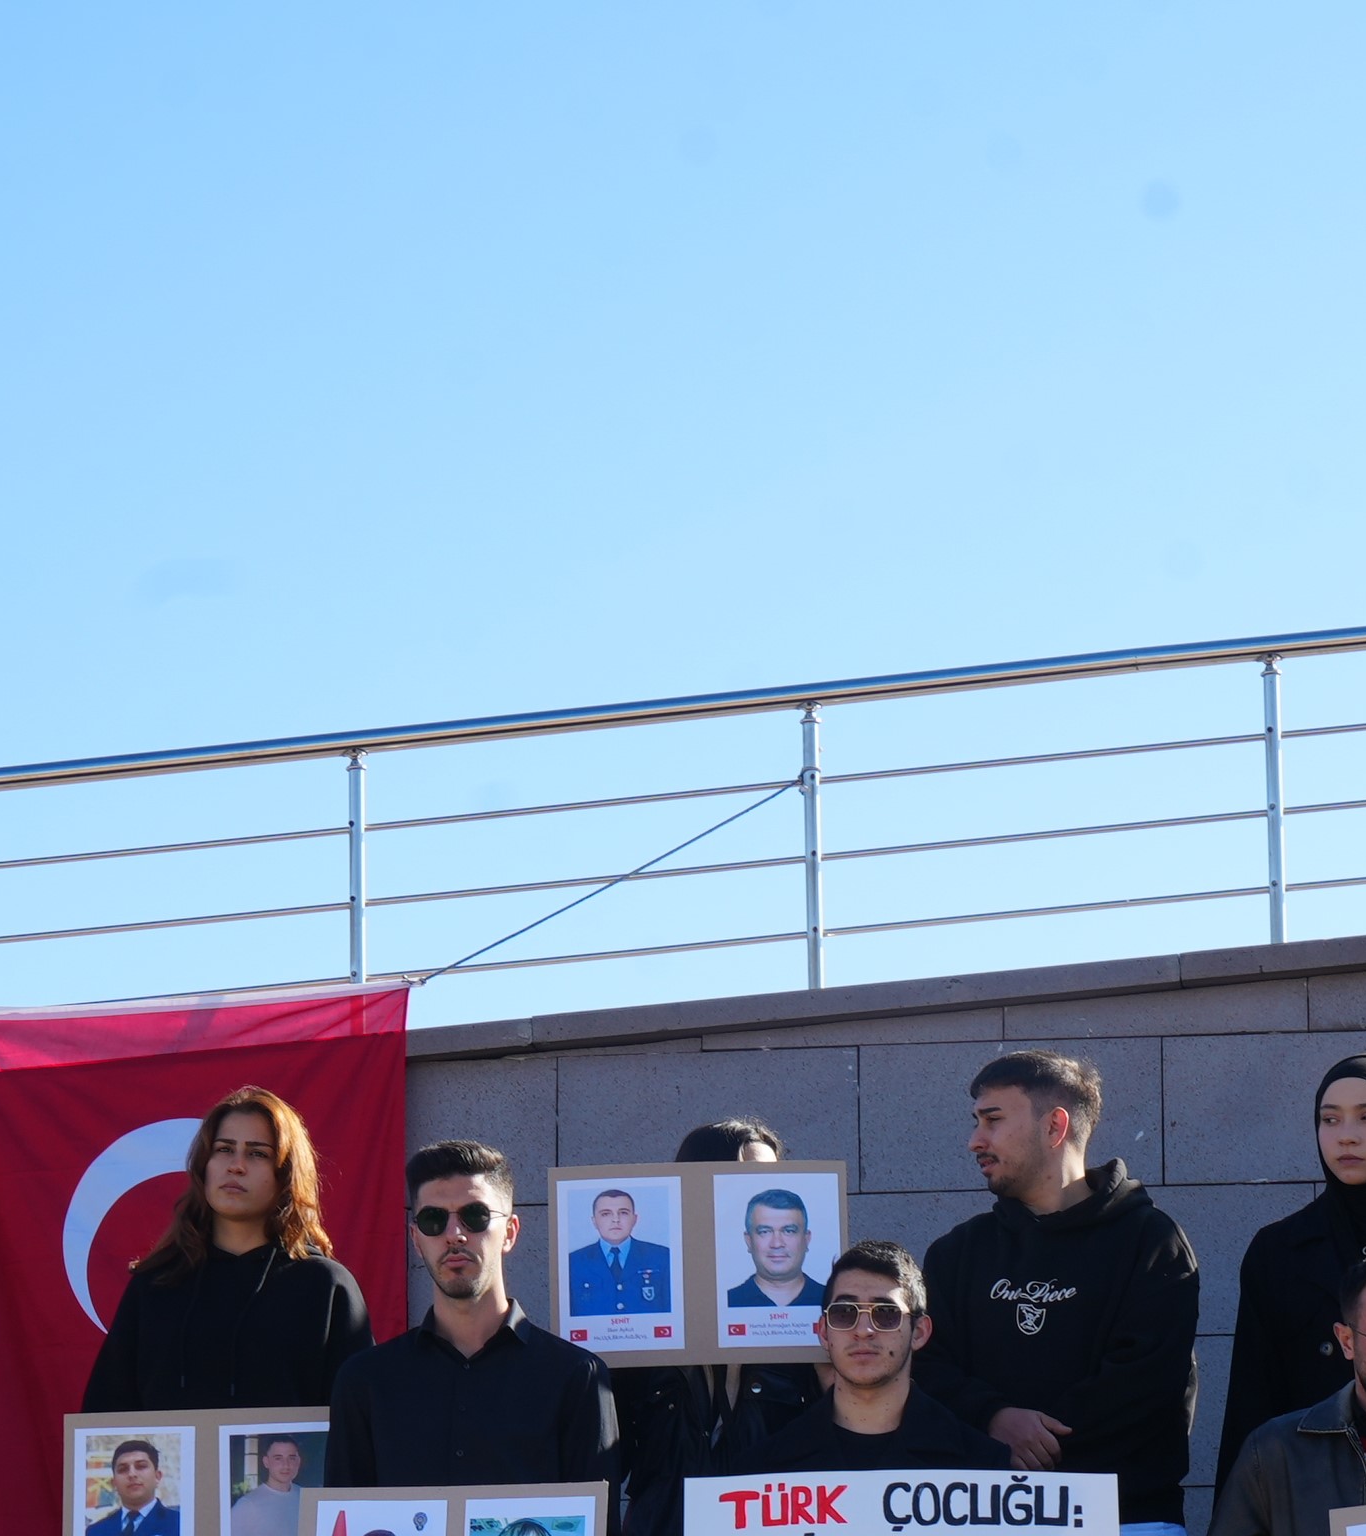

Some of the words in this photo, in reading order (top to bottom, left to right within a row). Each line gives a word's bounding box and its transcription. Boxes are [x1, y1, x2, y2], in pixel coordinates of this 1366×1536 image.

[1024, 1279, 1077, 1302] Piece
[611, 1317, 630, 1325] ŞEHİT
[719, 1483, 848, 1529] TÜRK
[883, 1475, 1084, 1532] ÇOCUĞU:
